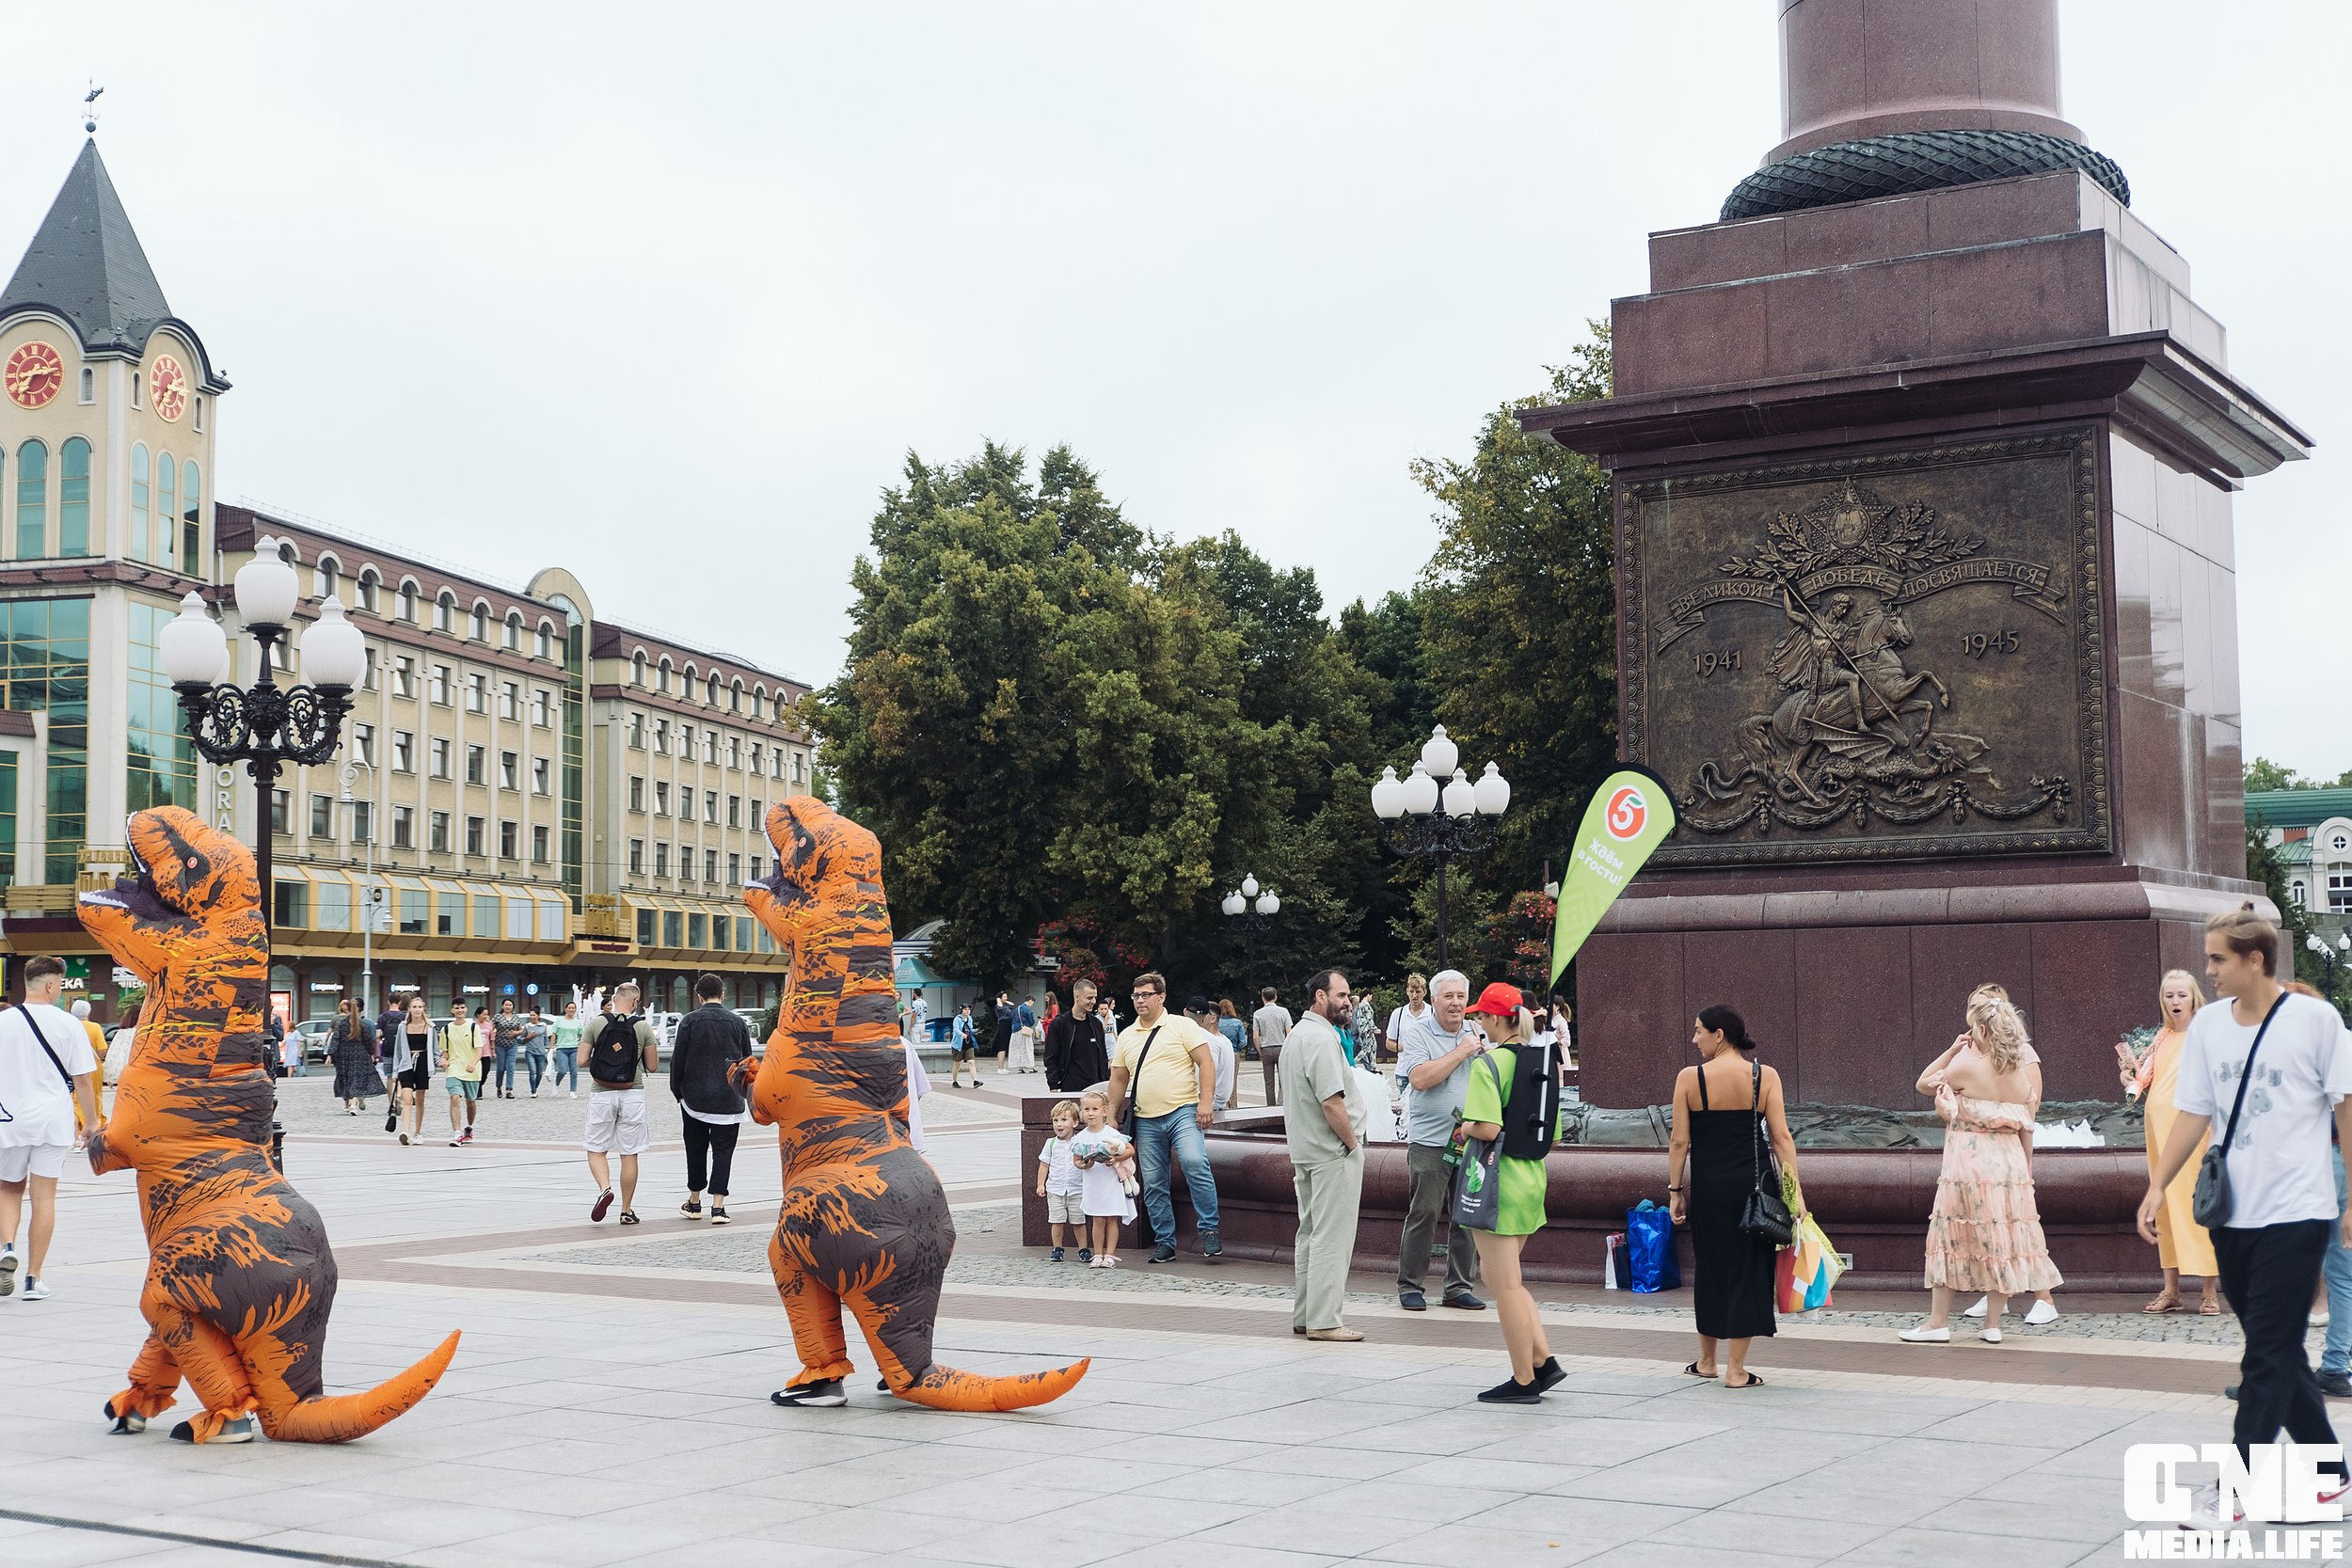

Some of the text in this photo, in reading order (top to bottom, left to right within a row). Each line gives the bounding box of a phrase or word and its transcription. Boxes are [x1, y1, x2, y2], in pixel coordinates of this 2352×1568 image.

[1811, 567, 1889, 590] ПОБЕДЕ
[1902, 560, 2041, 598] ПОСВЯЩАЕТСЯ
[1962, 628, 2020, 659] 1945
[1692, 649, 1741, 678] 1941
[1612, 793, 1645, 831] 5
[1584, 855, 1623, 887] гости!
